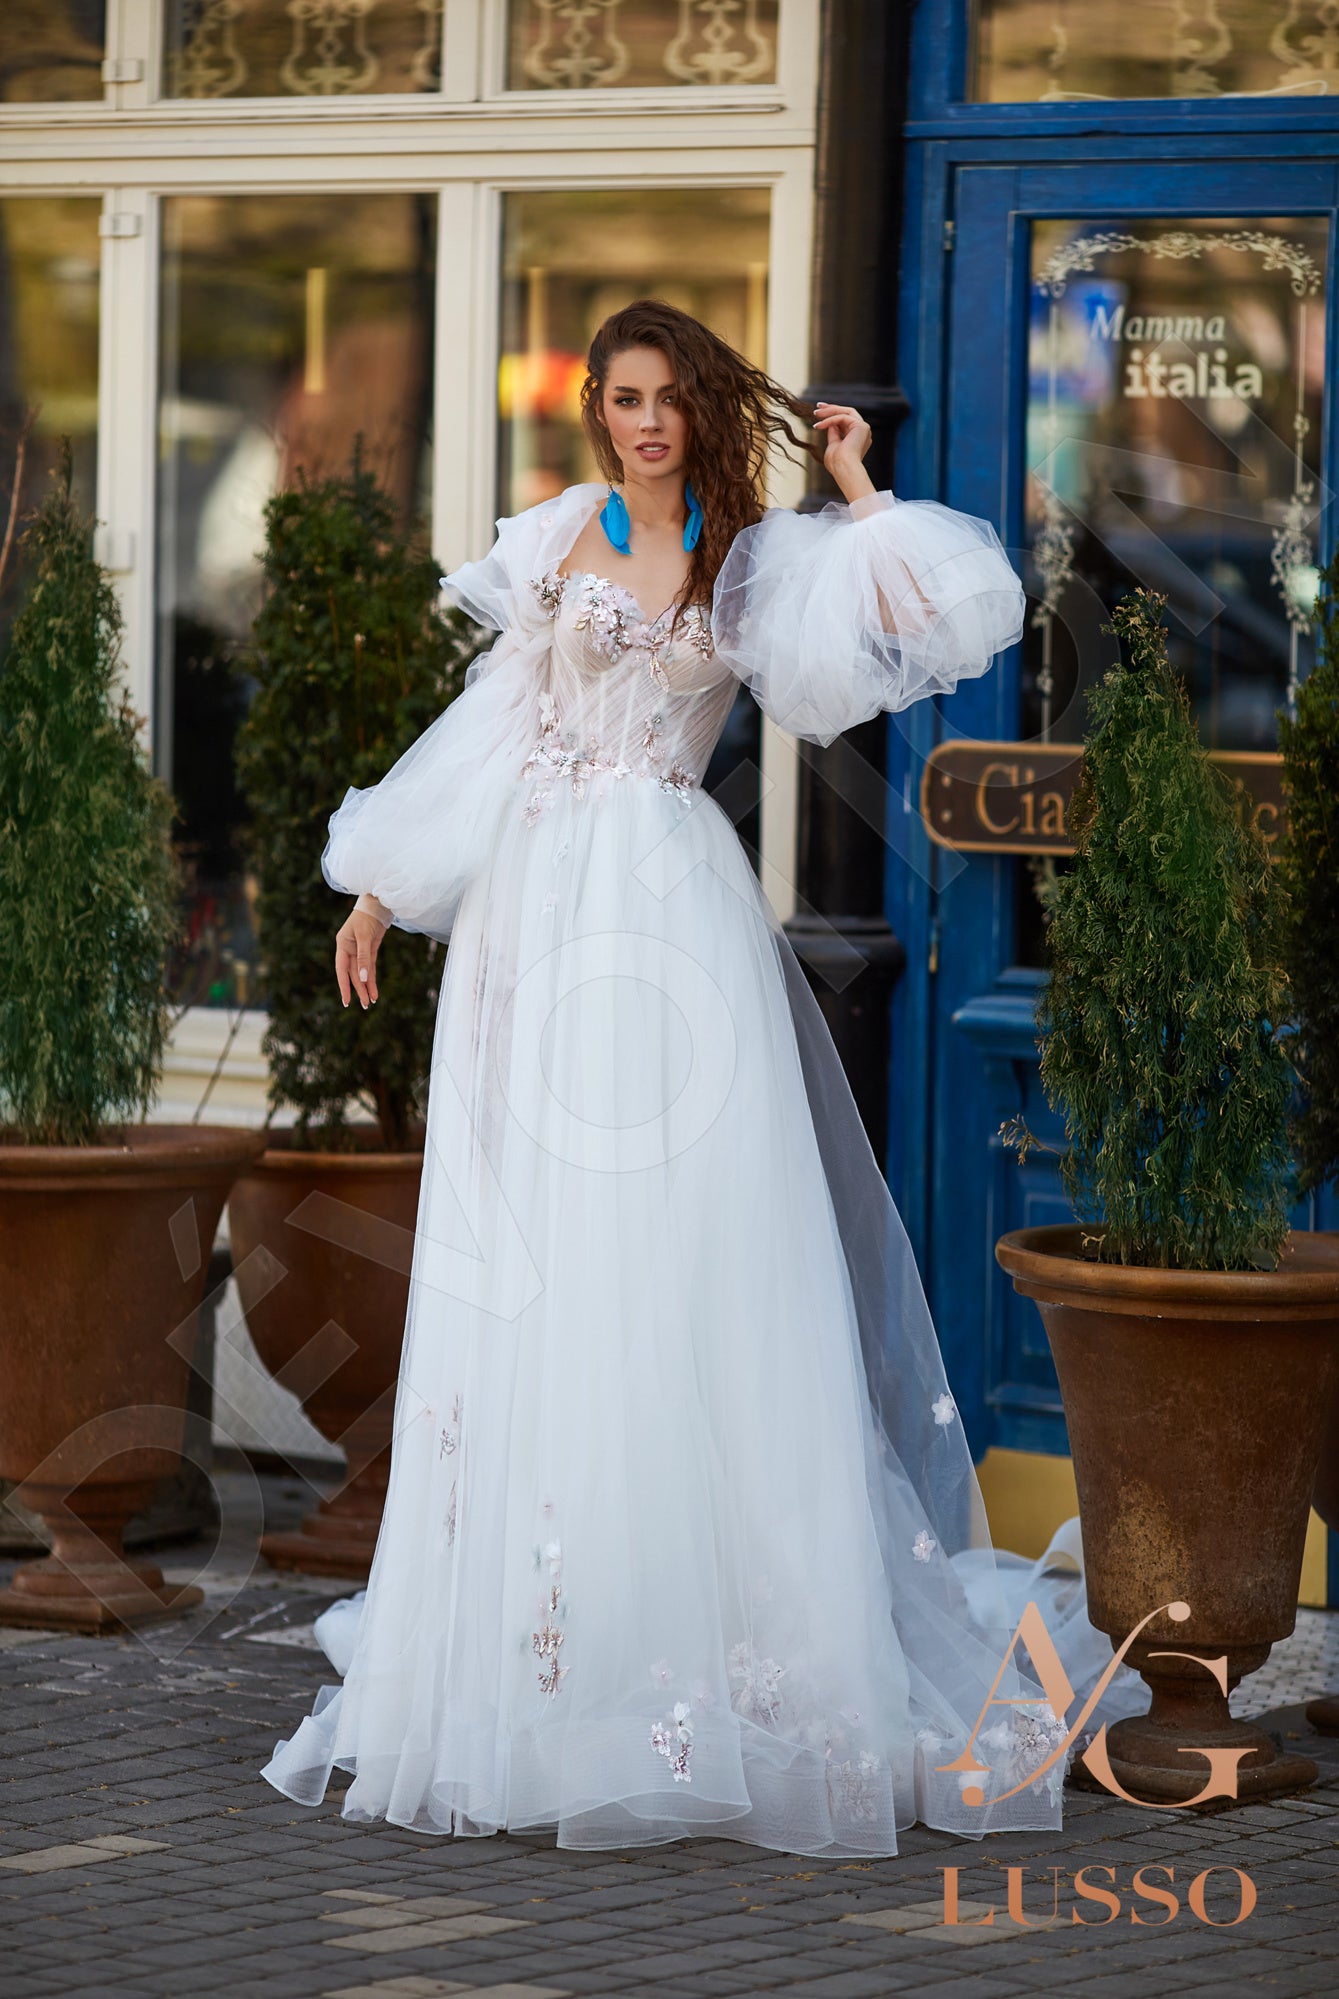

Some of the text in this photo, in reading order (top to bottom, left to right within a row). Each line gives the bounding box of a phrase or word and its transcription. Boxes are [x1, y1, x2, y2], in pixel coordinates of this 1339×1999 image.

[1089, 304, 1226, 342] Mamma
[1124, 348, 1263, 399] italia
[976, 763, 1067, 837] Cia
